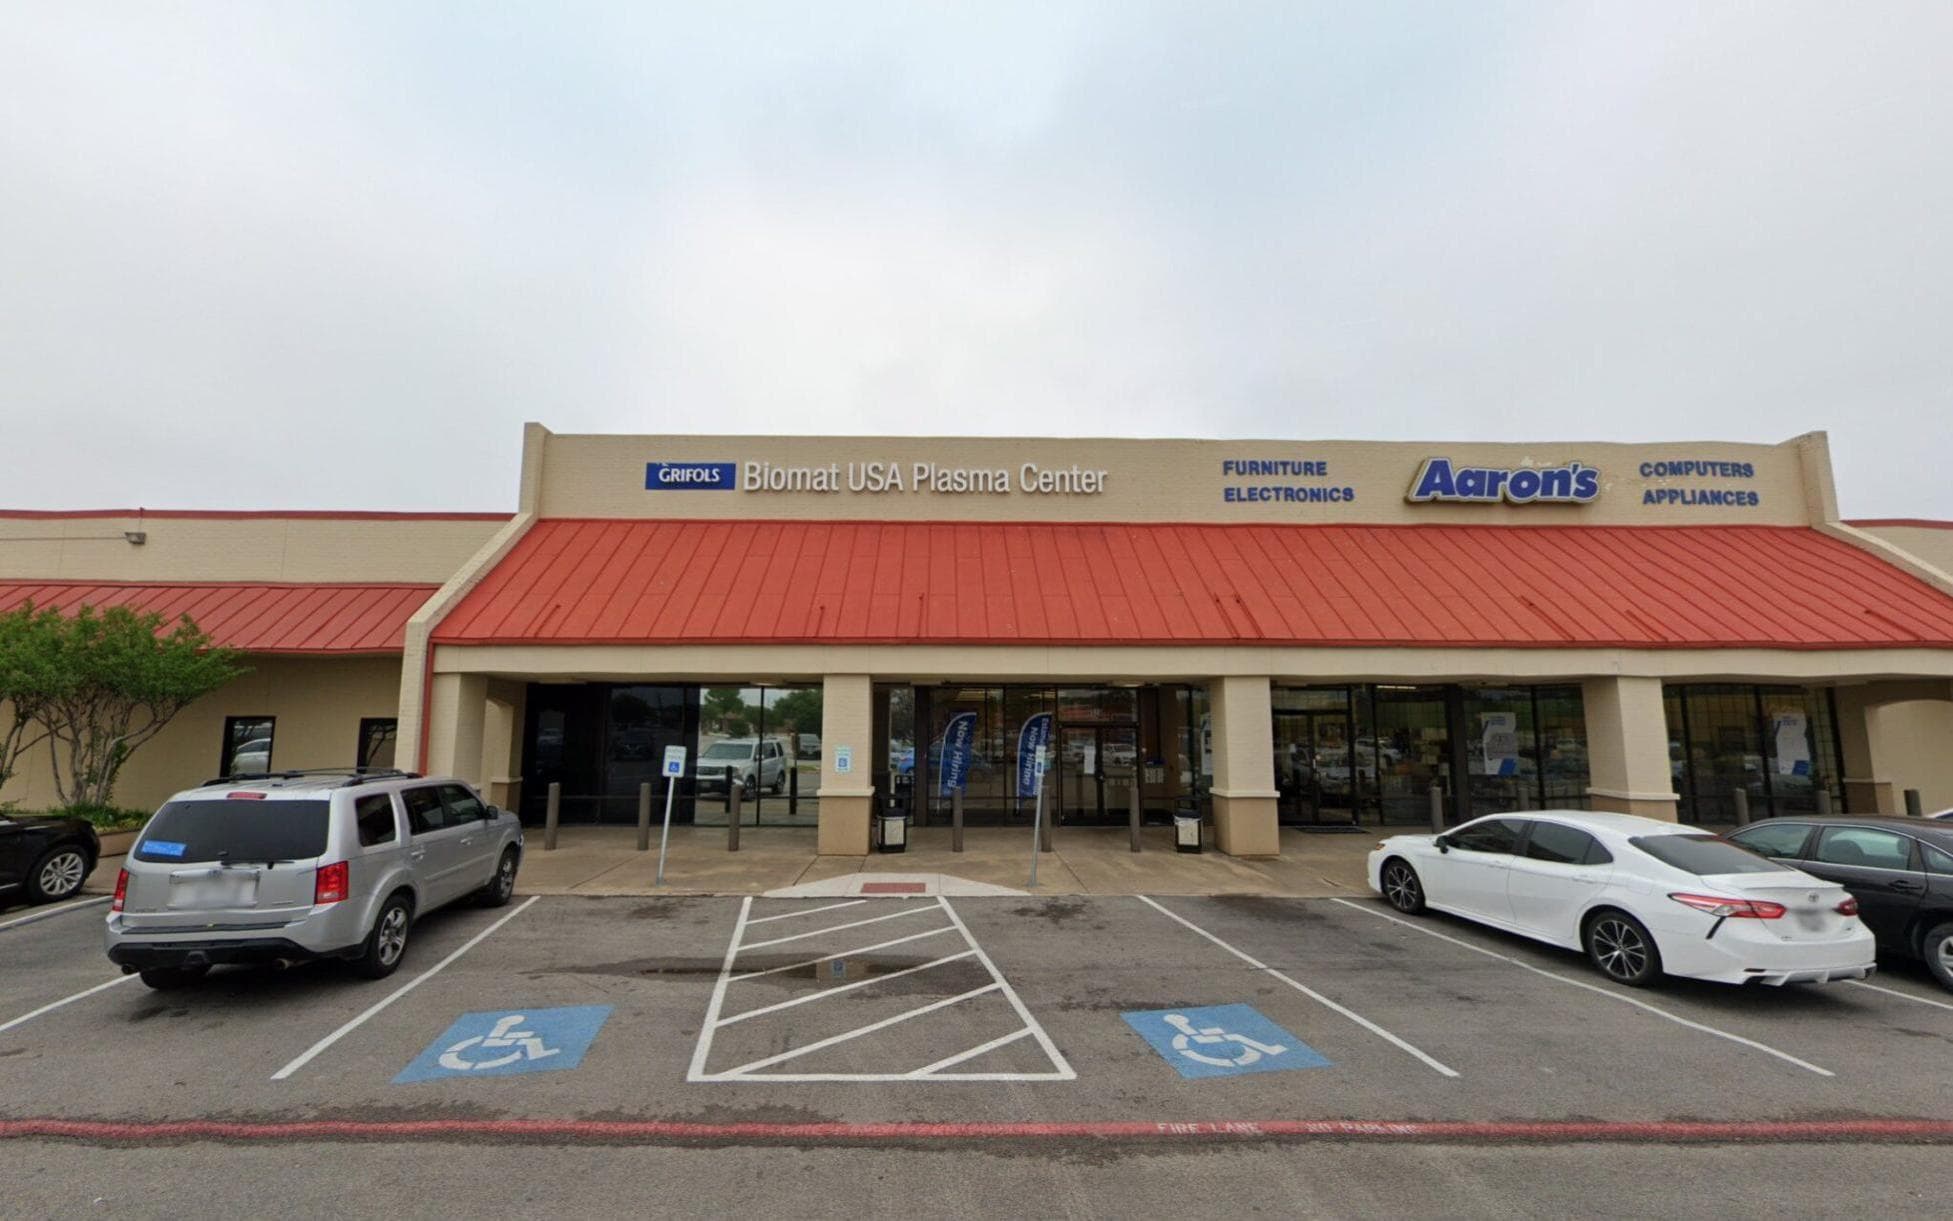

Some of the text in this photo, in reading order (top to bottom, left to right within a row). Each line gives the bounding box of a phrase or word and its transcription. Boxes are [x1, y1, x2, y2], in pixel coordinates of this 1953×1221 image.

[658, 468, 720, 483] GRIFOLS
[1223, 460, 1328, 476] FURNITURE
[1639, 460, 1755, 478] COMPUTERS
[743, 461, 1108, 494] Biomat USA Plasma Center
[1414, 459, 1599, 499] Aaron's
[1224, 486, 1355, 502] ELECTRONICS
[1642, 489, 1760, 506] APPLIANCES
[1027, 727, 1039, 751] Now
[947, 720, 969, 788] Now Hiring
[1158, 1123, 1197, 1135] FIRE
